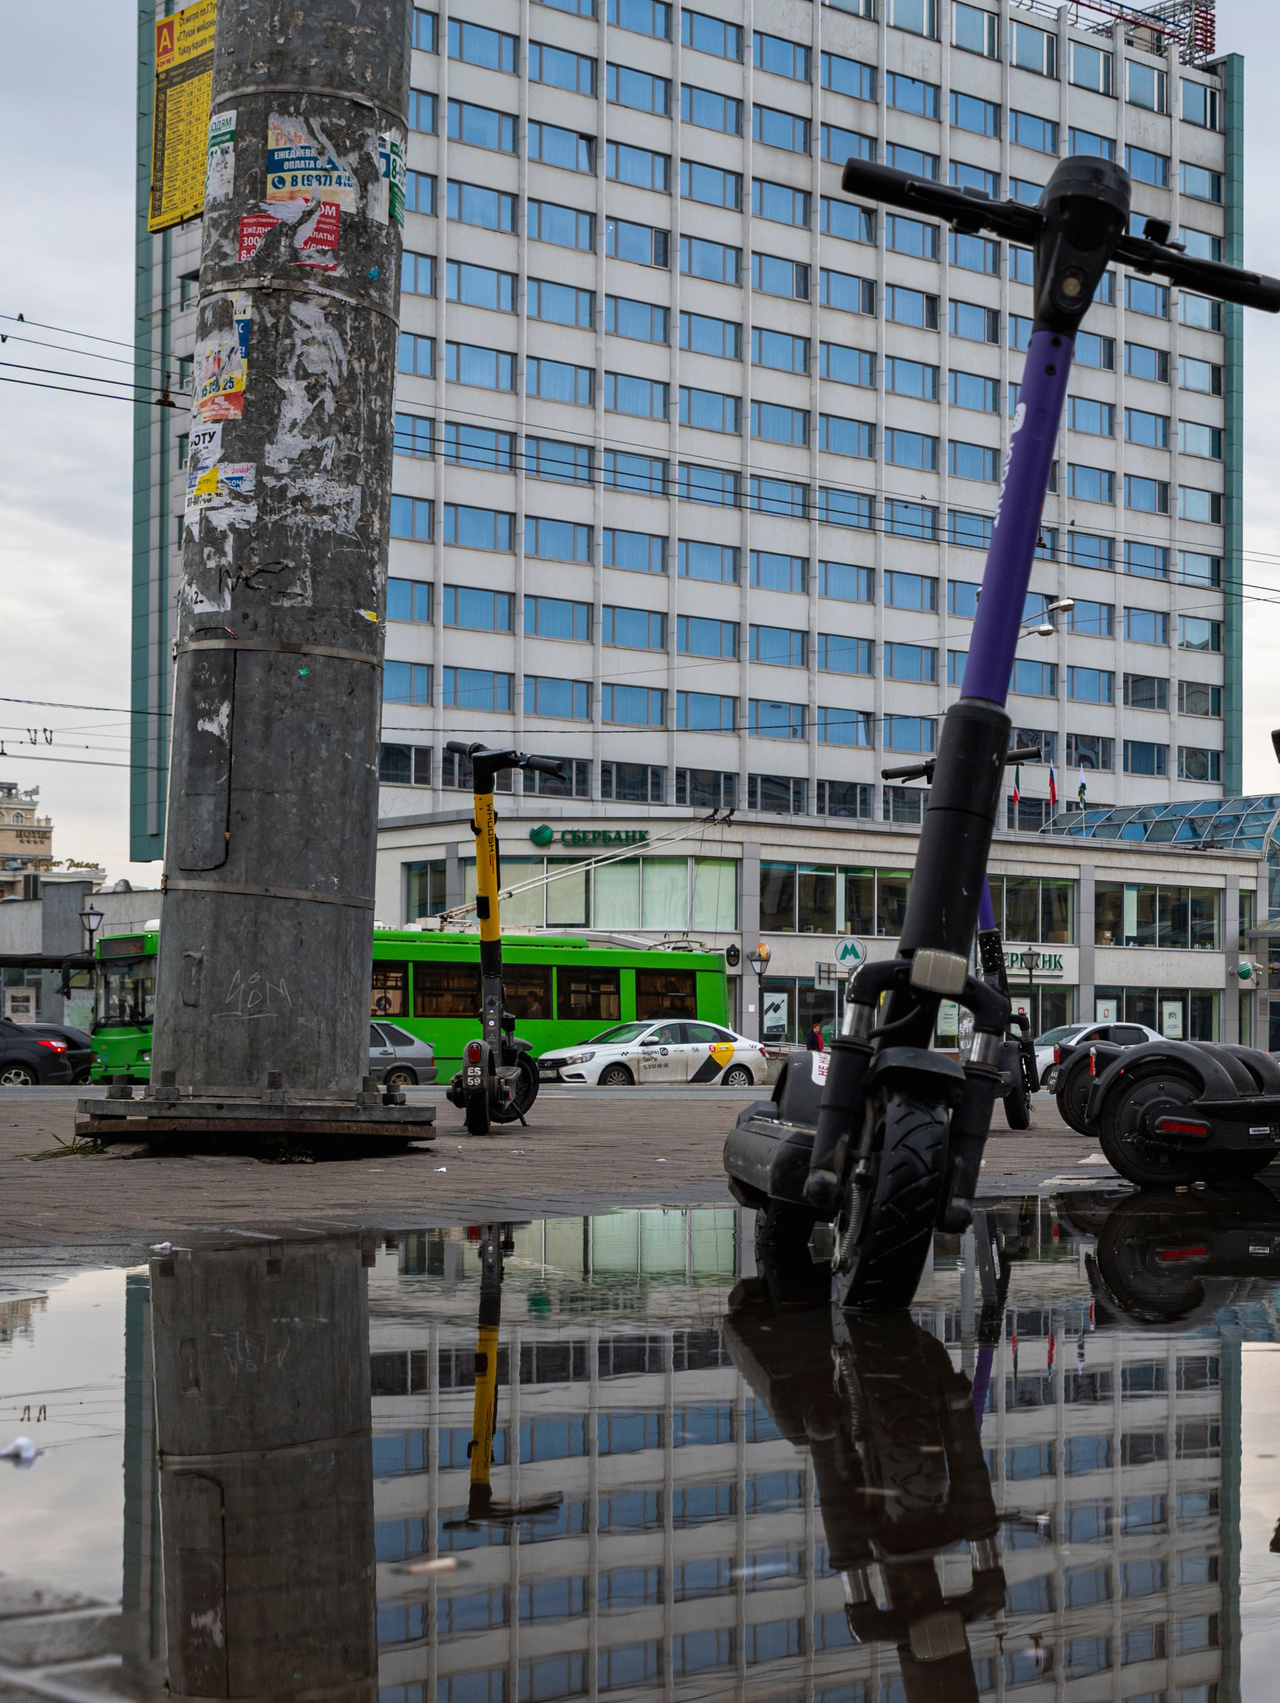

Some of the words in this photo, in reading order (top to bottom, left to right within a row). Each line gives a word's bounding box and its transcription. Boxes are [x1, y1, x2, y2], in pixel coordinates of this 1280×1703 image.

[283, 160, 316, 171] ОПЛАТА
[290, 174, 299, 188] 8
[486, 802, 495, 853] WHOOSH
[15, 829, 50, 840] HOTEL
[561, 830, 650, 844] СБЕРБАНК
[467, 1066, 482, 1076] ES
[467, 1077, 481, 1086] 59
